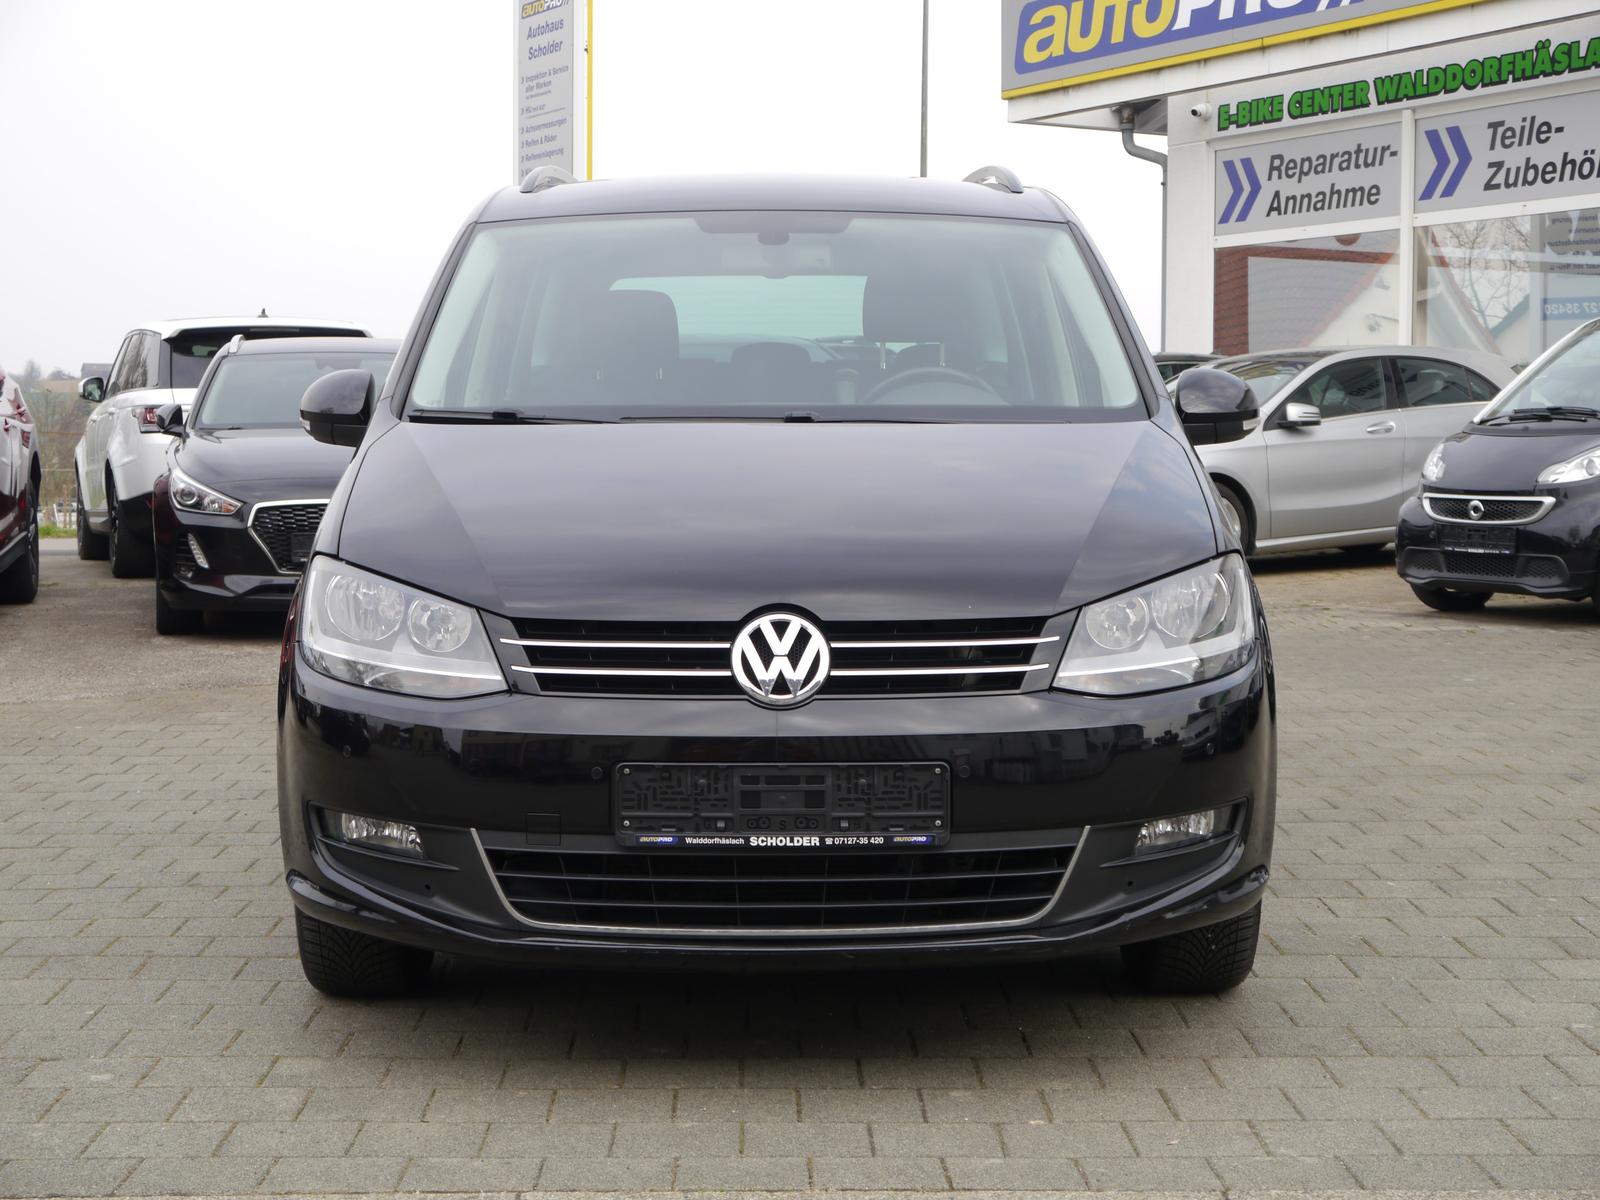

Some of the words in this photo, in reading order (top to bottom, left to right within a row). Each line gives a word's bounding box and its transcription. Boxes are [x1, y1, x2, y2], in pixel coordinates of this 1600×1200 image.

[526, 18, 564, 40] Autohaus
[528, 40, 563, 60] Scholder
[1217, 94, 1284, 132] E-BIKE
[1287, 80, 1371, 120] CENTER
[1486, 115, 1565, 152] Teile-
[1267, 144, 1399, 183] Reparatur-
[1265, 184, 1381, 217] Annahme
[685, 836, 745, 845] Walddorfhäslach
[749, 836, 820, 847] SCHOLDER
[834, 836, 869, 845] 07127-35
[870, 836, 884, 844] 420
